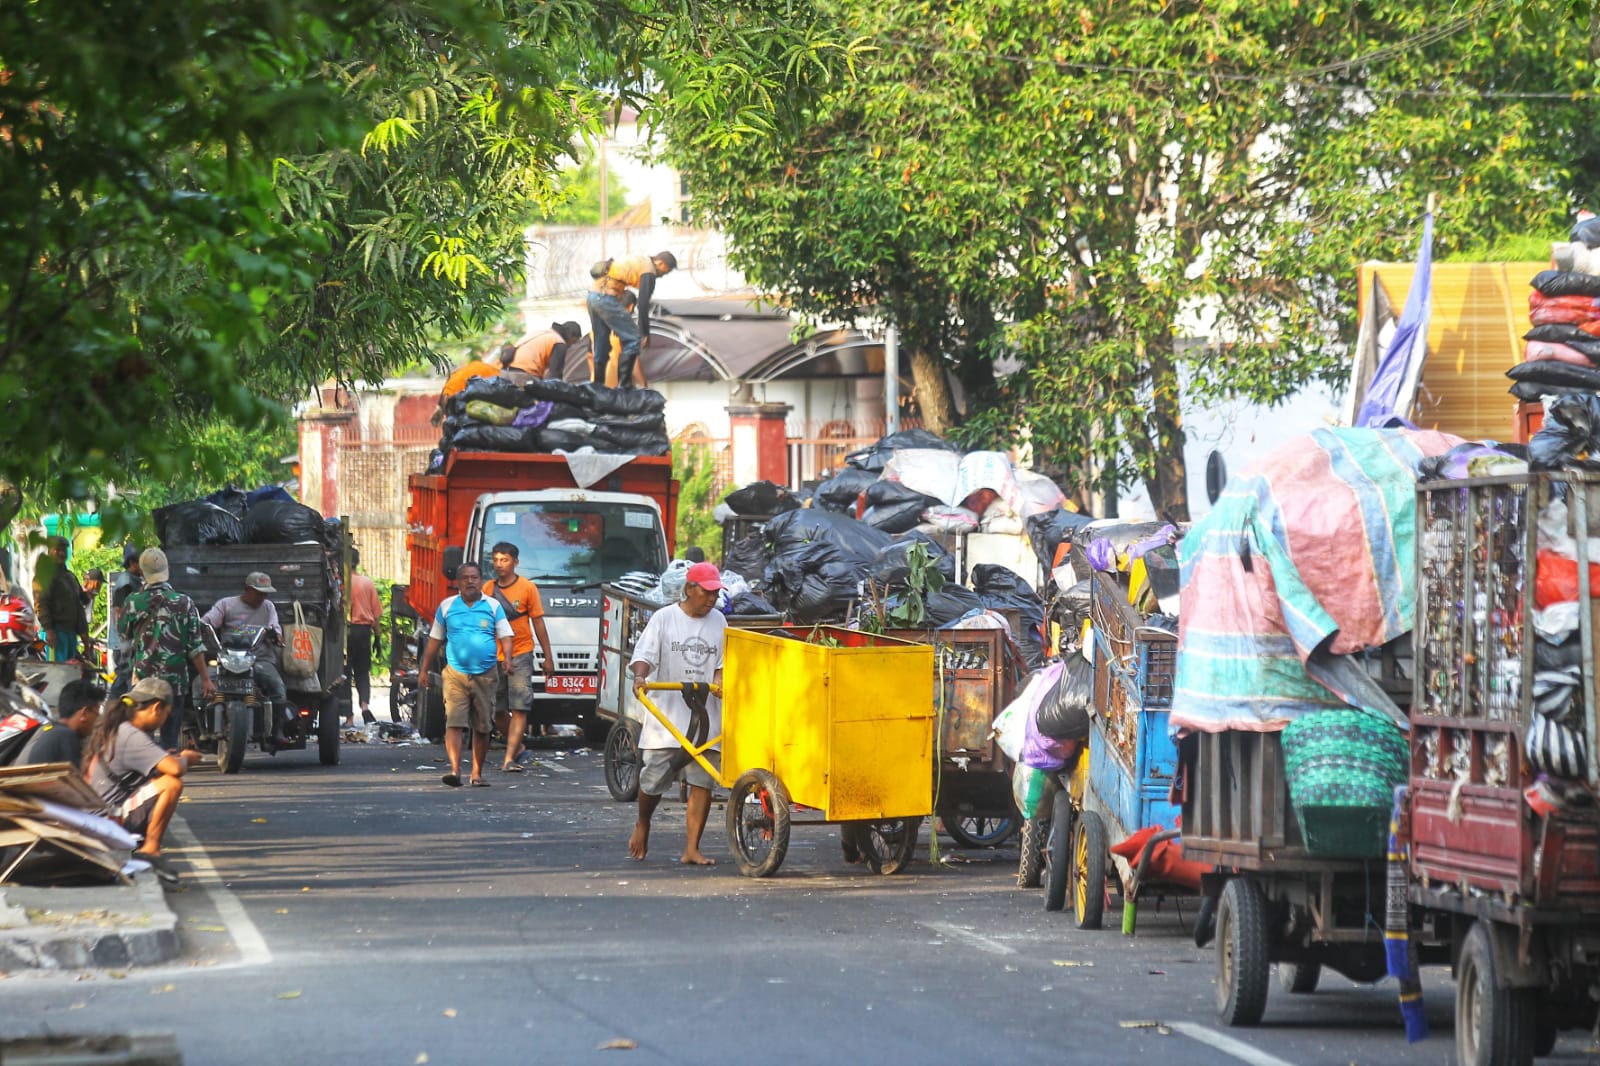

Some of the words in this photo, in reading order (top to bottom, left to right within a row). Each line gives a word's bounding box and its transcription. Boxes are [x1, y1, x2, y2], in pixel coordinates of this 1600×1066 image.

[549, 598, 598, 607] ISUZU
[547, 677, 558, 687] AB
[562, 677, 584, 688] 8344
